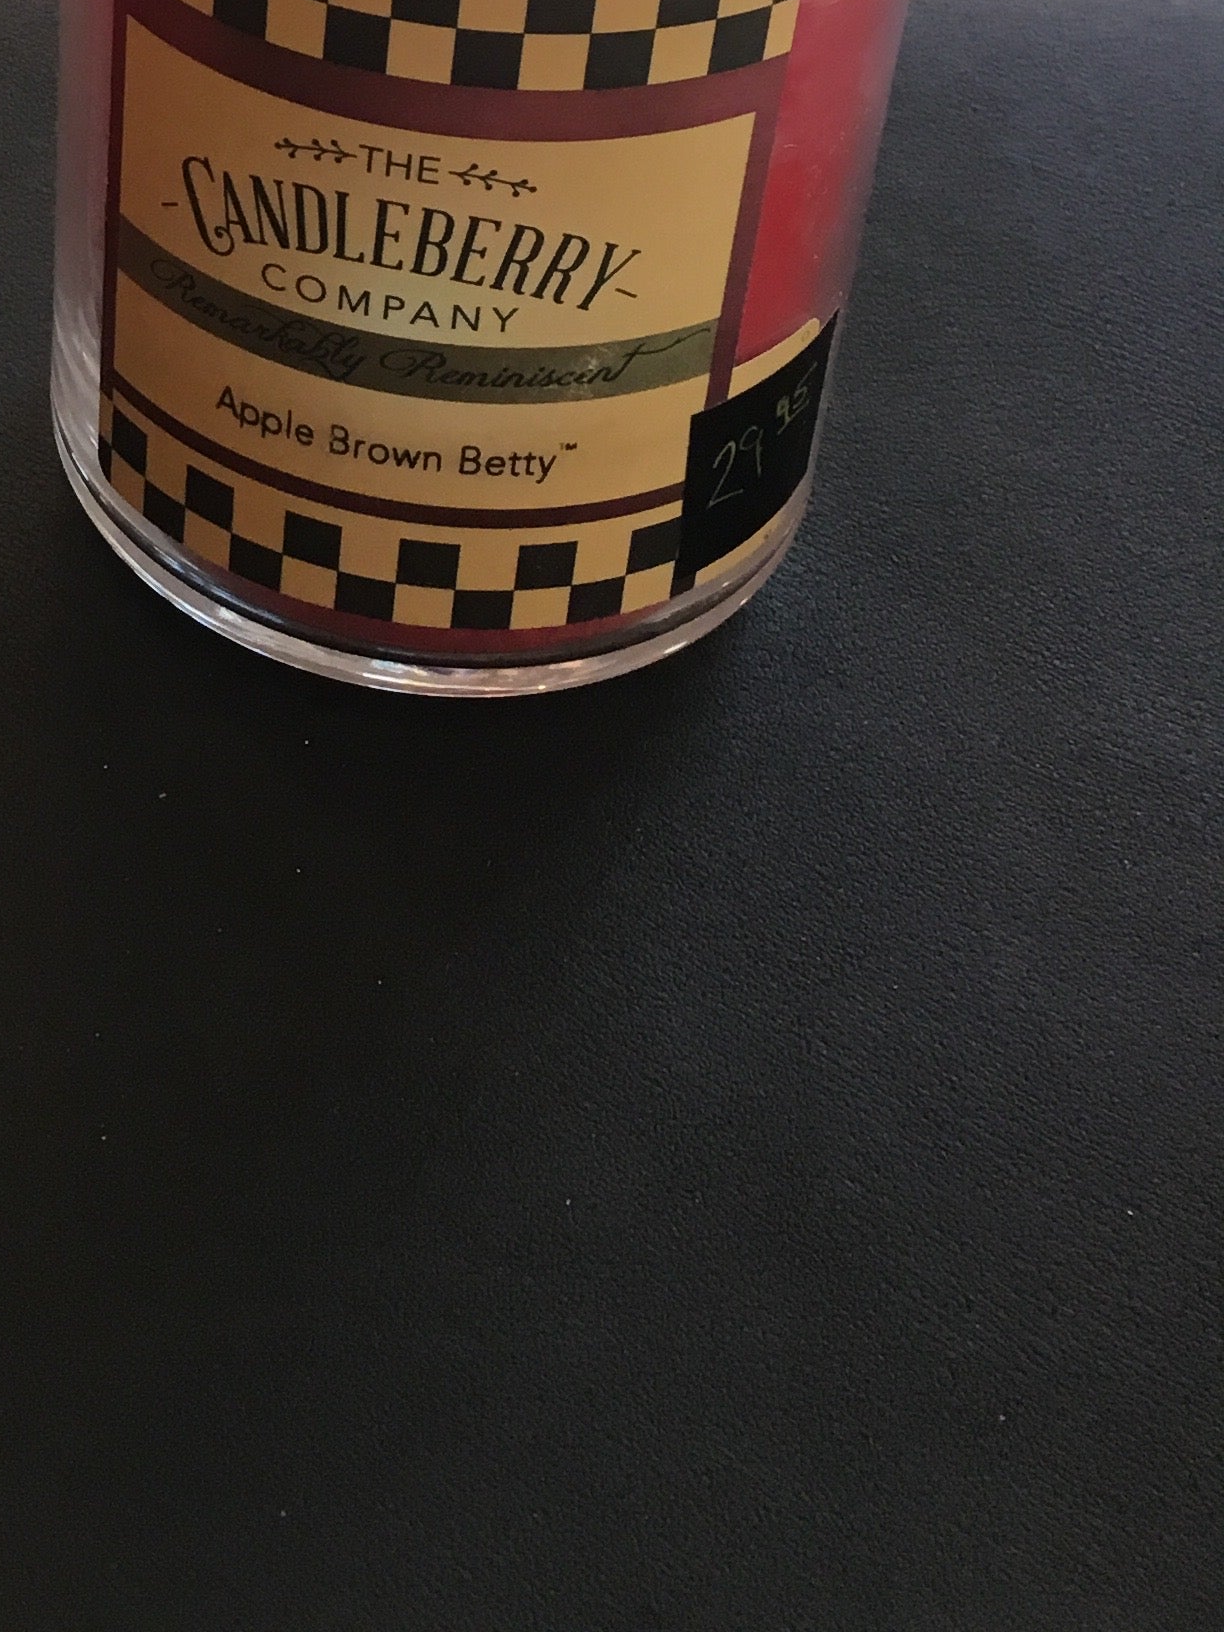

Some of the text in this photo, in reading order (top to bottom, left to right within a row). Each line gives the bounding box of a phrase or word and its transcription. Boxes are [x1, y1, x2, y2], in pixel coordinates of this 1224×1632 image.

[357, 145, 442, 184] THE
[181, 156, 642, 312] CANDLEBERRY
[150, 260, 712, 388] Remarkably Reminiscent
[262, 262, 520, 332] COMPANY
[216, 385, 315, 447] Apple
[329, 425, 442, 472] Brown
